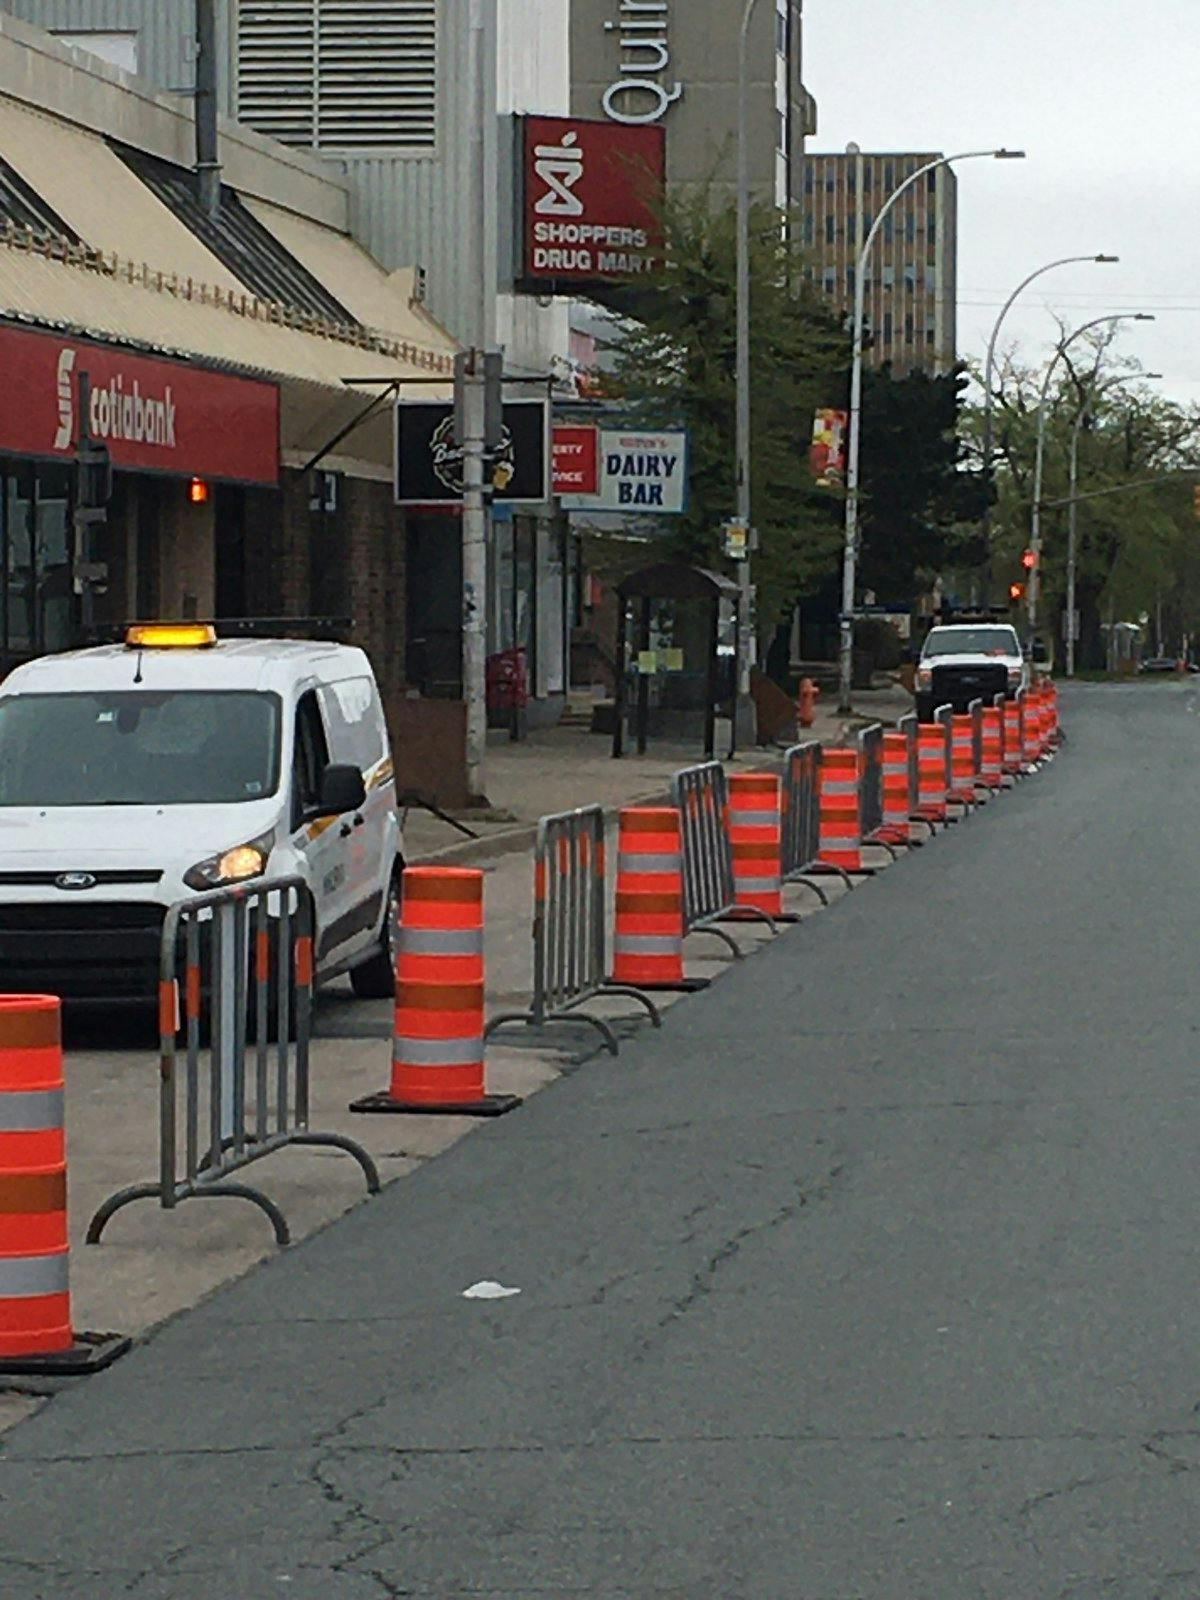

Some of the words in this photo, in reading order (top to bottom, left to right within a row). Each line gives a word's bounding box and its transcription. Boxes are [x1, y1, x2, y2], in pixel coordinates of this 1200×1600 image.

[533, 221, 647, 248] SHOPPERS
[533, 248, 592, 270] DRUG
[80, 372, 176, 449] cotiabank
[606, 454, 677, 477] DAIRY
[618, 482, 663, 506] BAR
